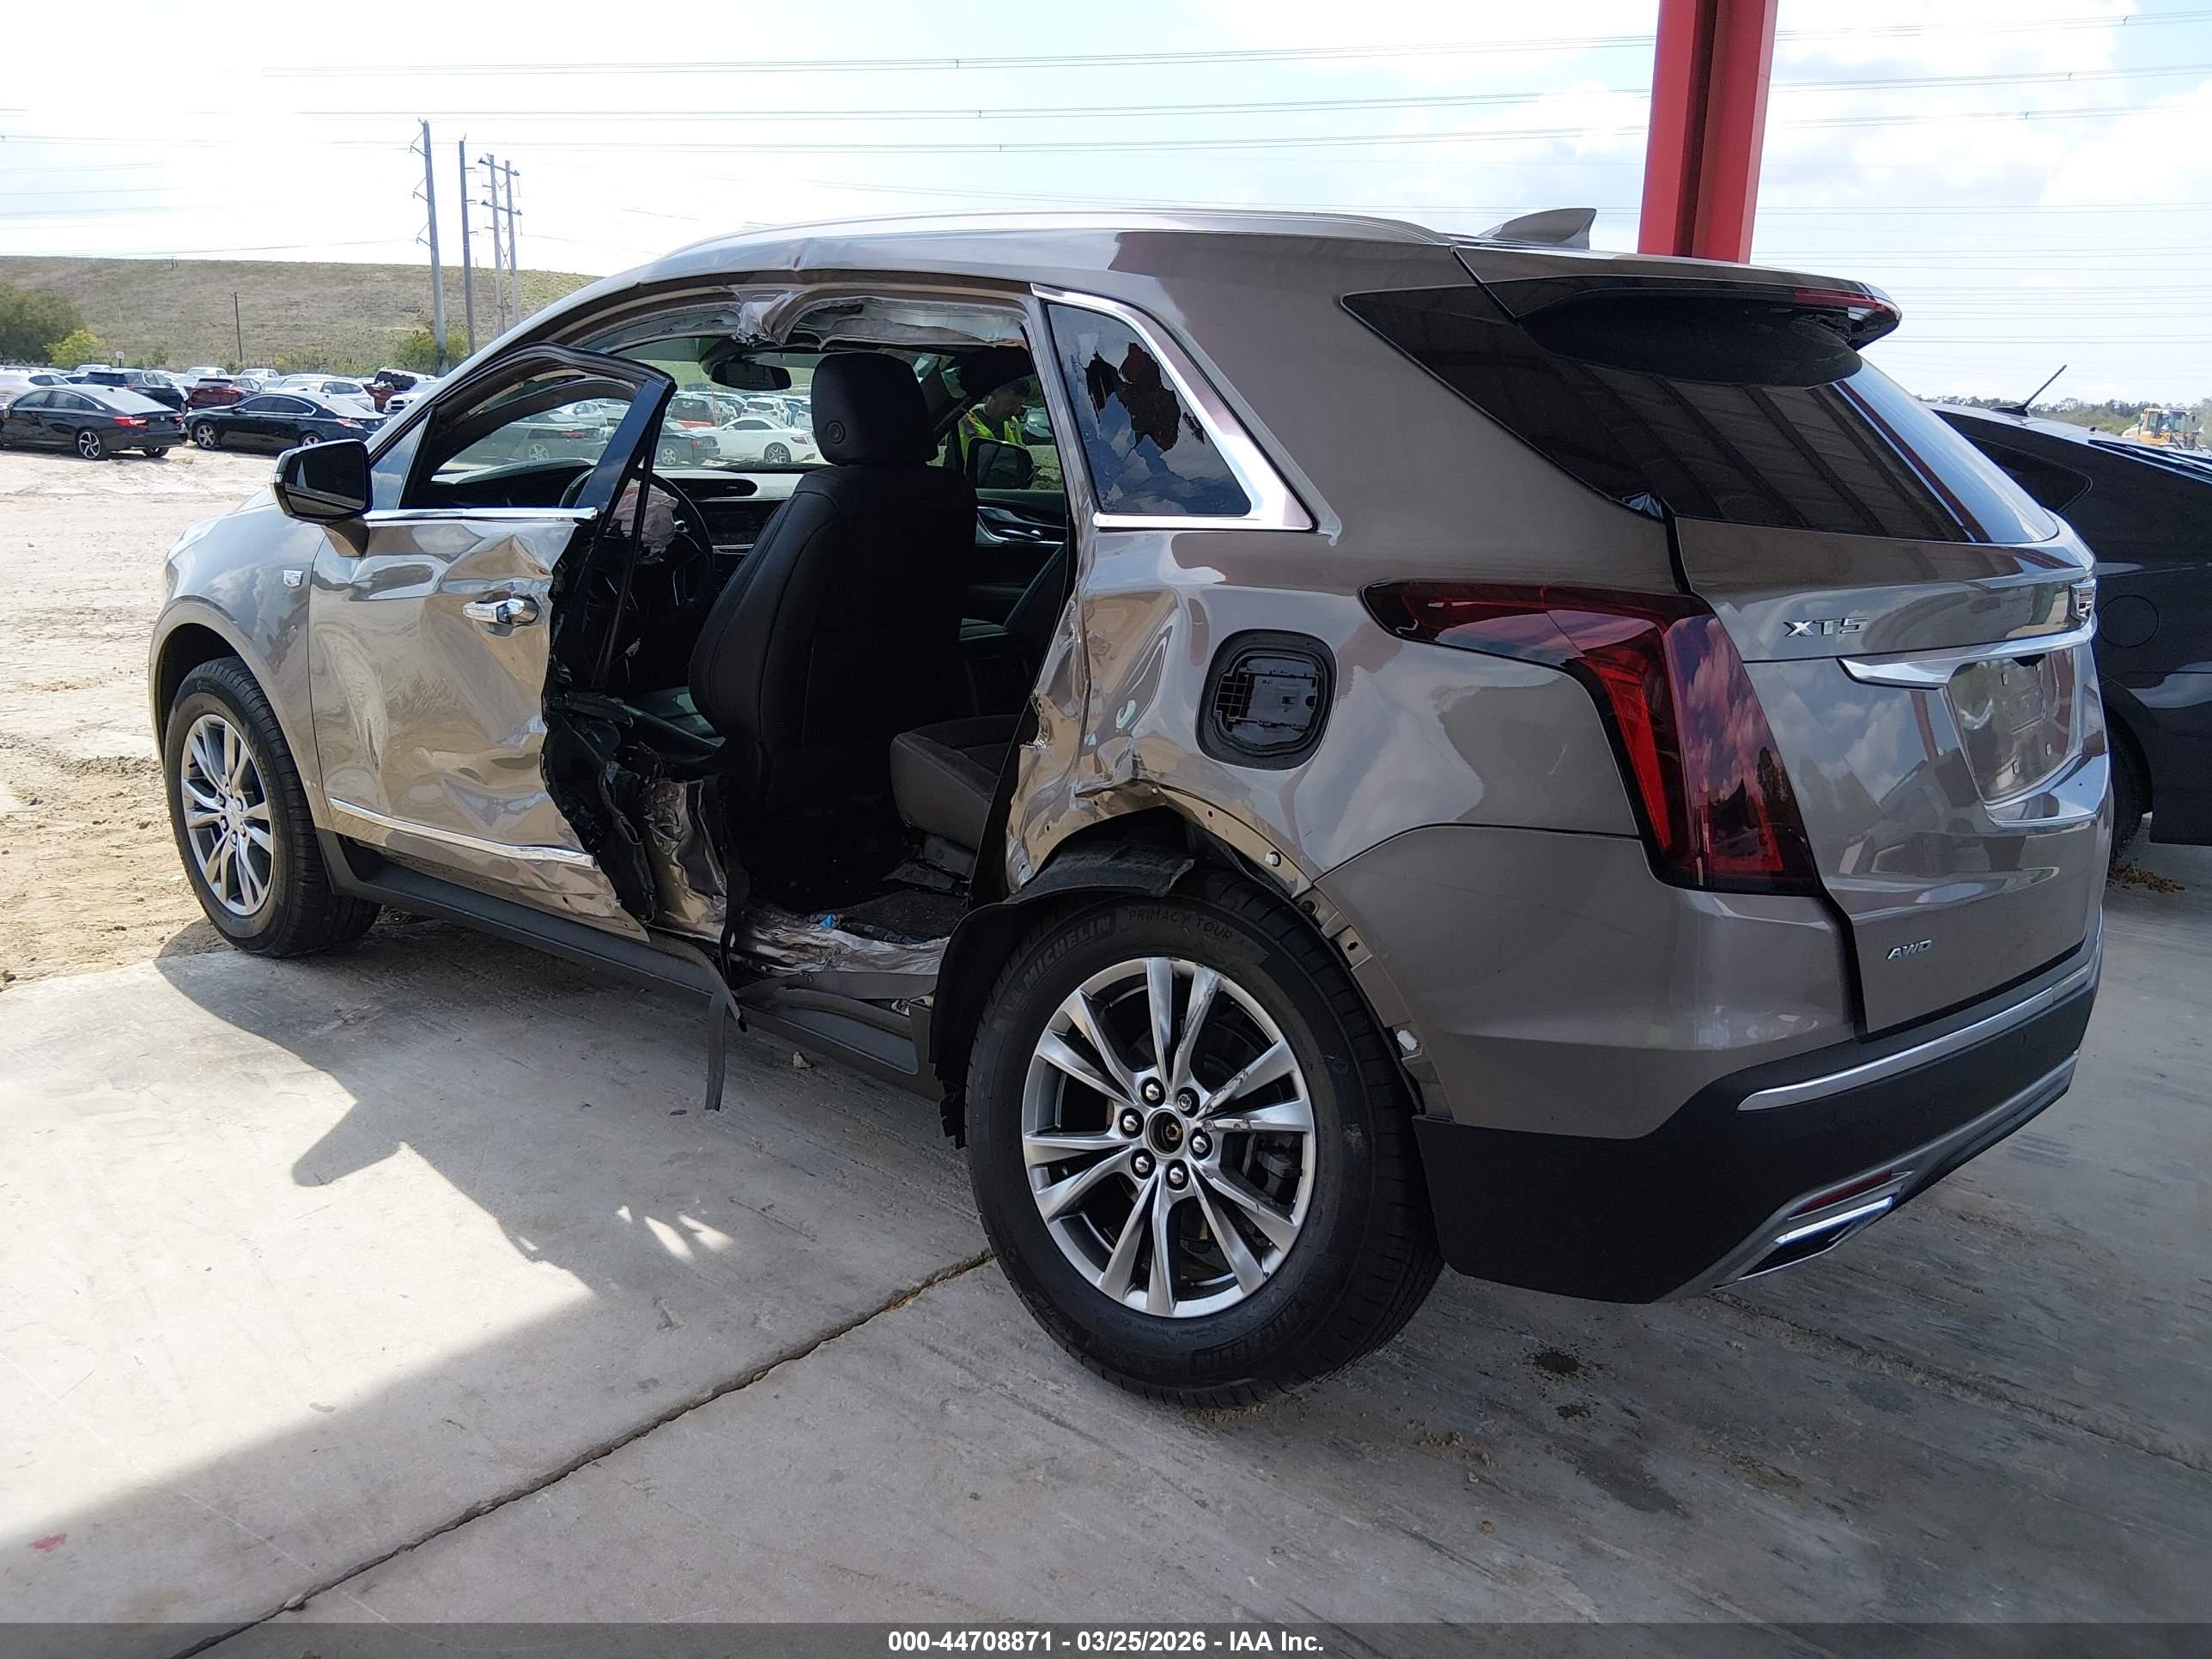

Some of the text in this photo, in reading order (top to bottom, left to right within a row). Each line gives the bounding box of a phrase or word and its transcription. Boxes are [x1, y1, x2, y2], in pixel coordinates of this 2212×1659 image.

[1783, 617, 1869, 638] XT5
[1127, 909, 1234, 942] PRIMACY TOUR
[1022, 915, 1113, 991] MICHELIN
[1886, 939, 1933, 960] AWD
